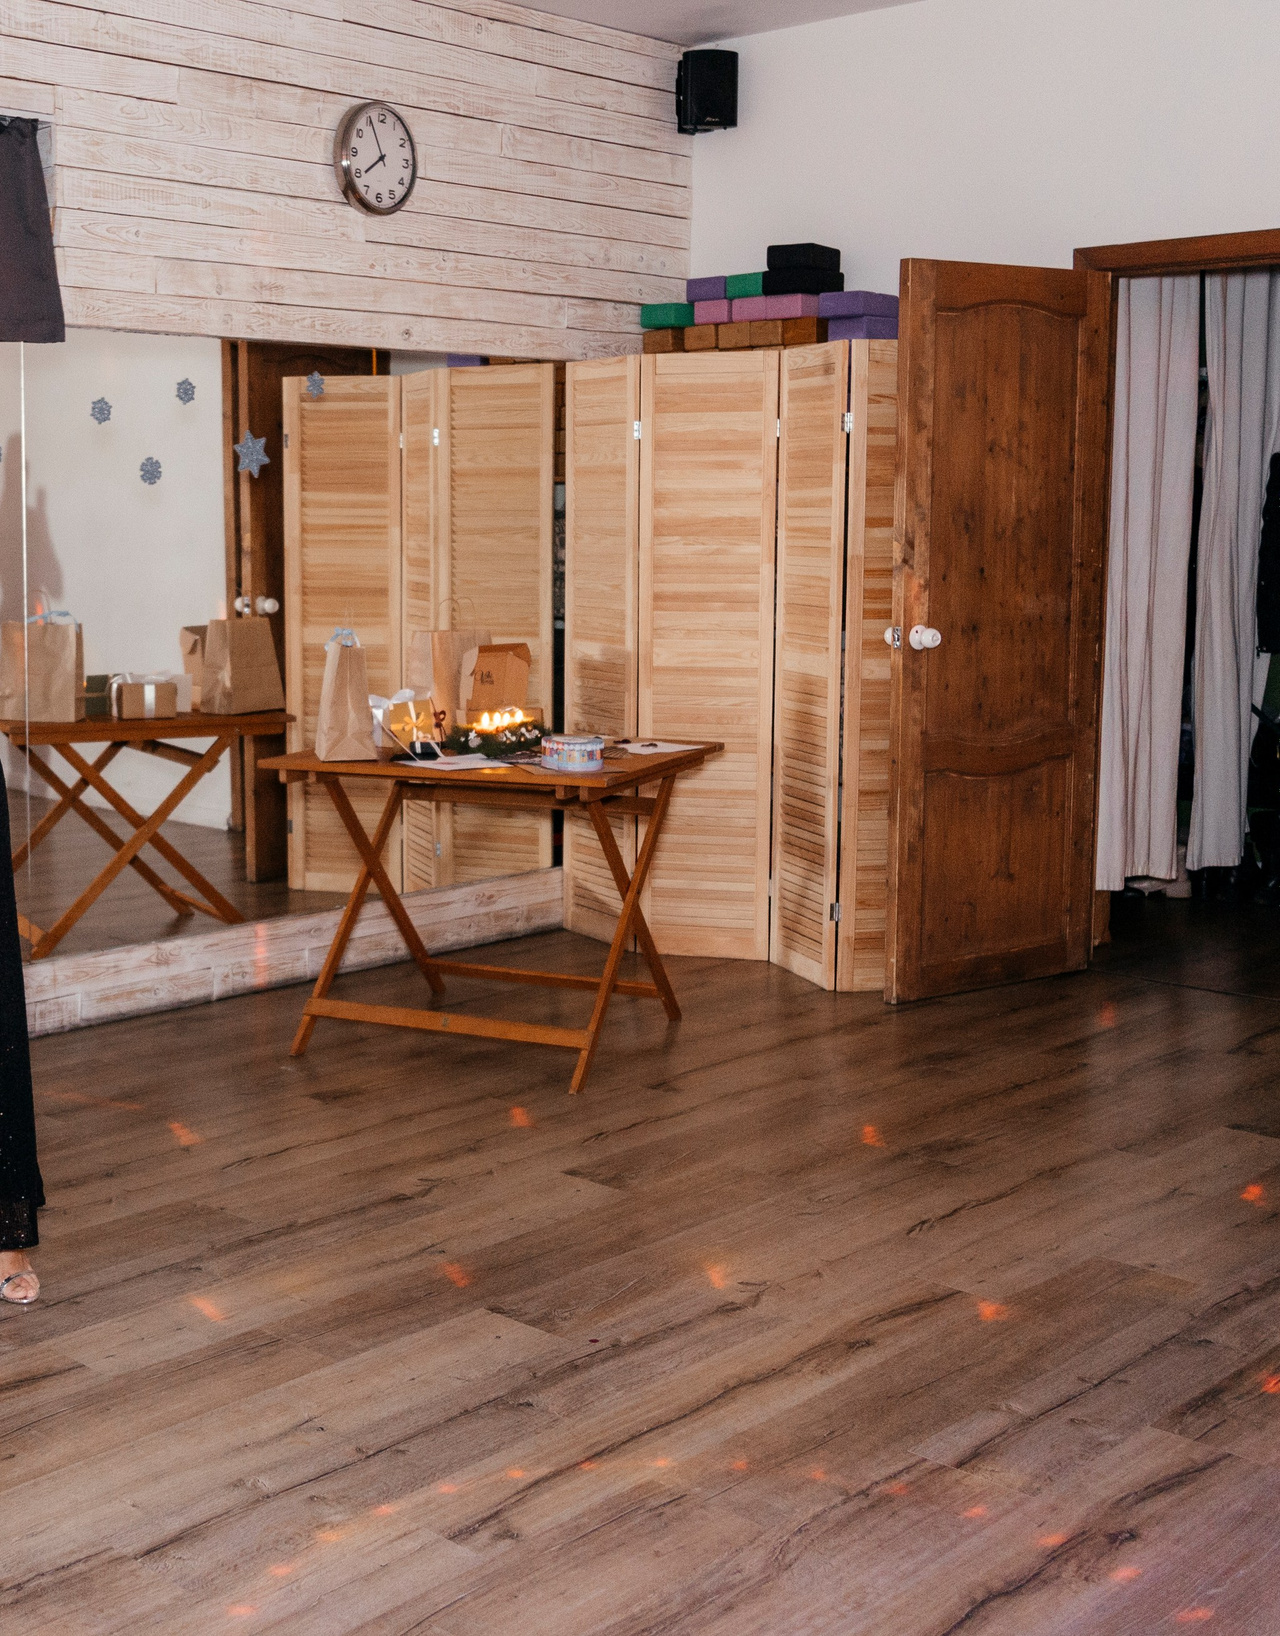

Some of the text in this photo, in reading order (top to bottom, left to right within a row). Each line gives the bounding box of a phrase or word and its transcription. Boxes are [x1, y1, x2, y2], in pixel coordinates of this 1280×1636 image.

[378, 114, 386, 124] 12
[356, 128, 363, 138] 10
[399, 138, 406, 148] 2
[351, 147, 358, 157] 9
[402, 158, 409, 169] 3
[354, 168, 362, 178] 8
[398, 177, 405, 186] 4
[364, 185, 370, 195] 7
[389, 190, 396, 200] 5
[376, 193, 382, 203] 6
